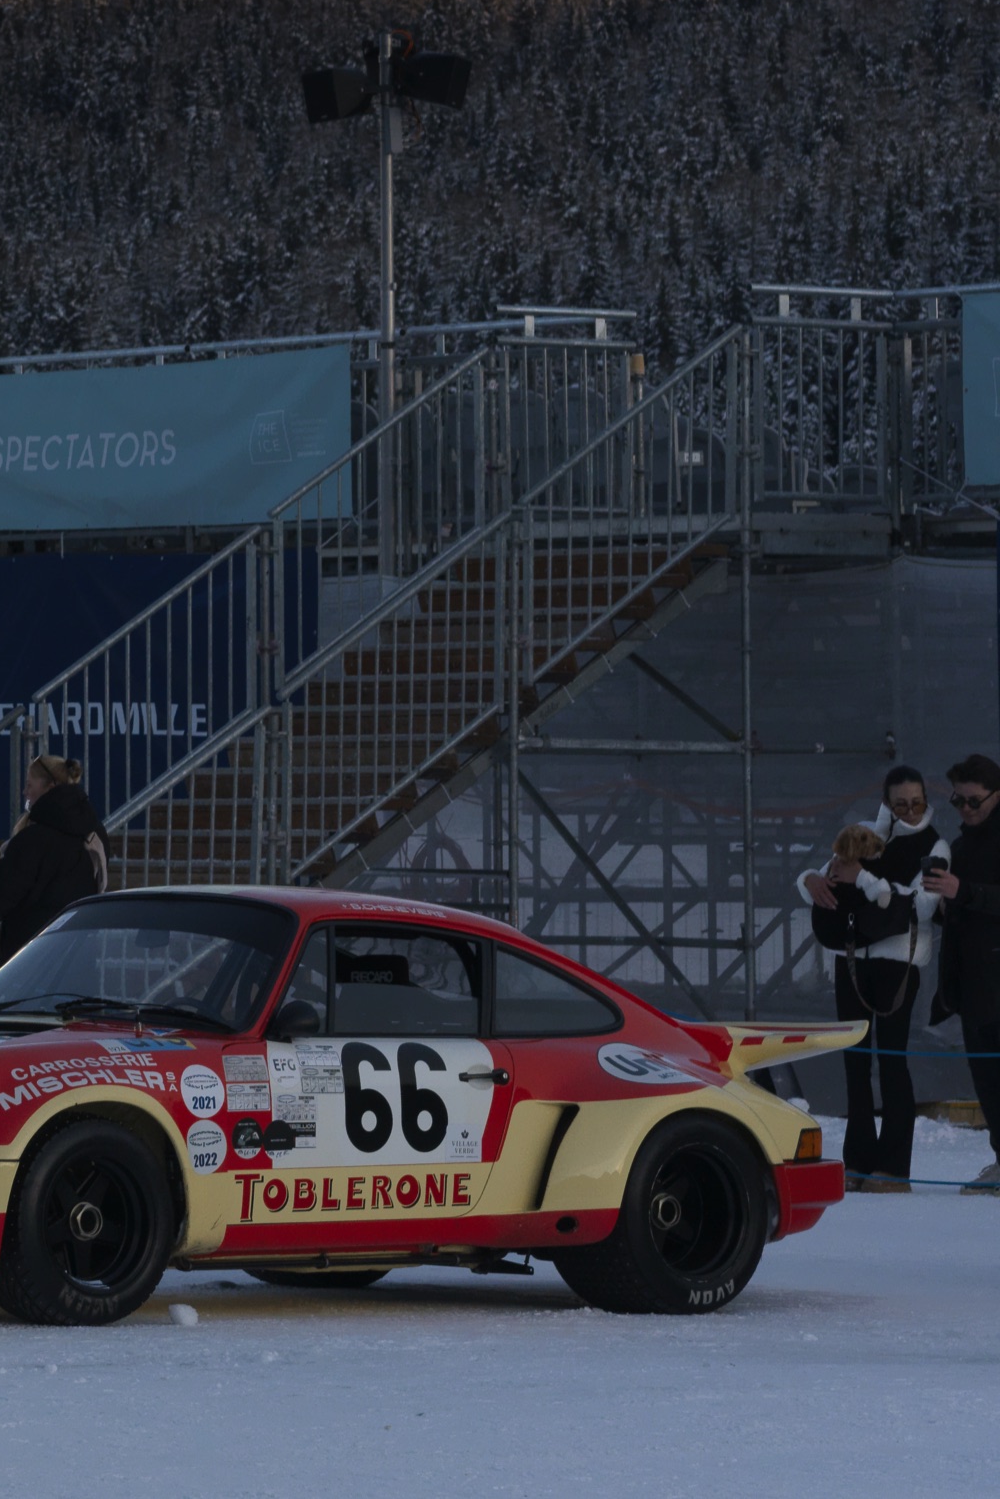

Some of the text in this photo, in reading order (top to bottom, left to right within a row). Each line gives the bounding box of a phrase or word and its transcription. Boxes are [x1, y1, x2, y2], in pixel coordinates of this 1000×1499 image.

[112, 701, 208, 737] MILLE
[350, 970, 394, 983] RECARO
[10, 1052, 158, 1081] CARROSSERIE
[165, 1071, 176, 1080] S
[169, 1083, 178, 1092] A
[341, 1042, 448, 1153] 66
[192, 1096, 216, 1110] 2021
[193, 1152, 218, 1168] 2022
[235, 1173, 471, 1222] TOBLERONE
[688, 1278, 735, 1306] AVON
